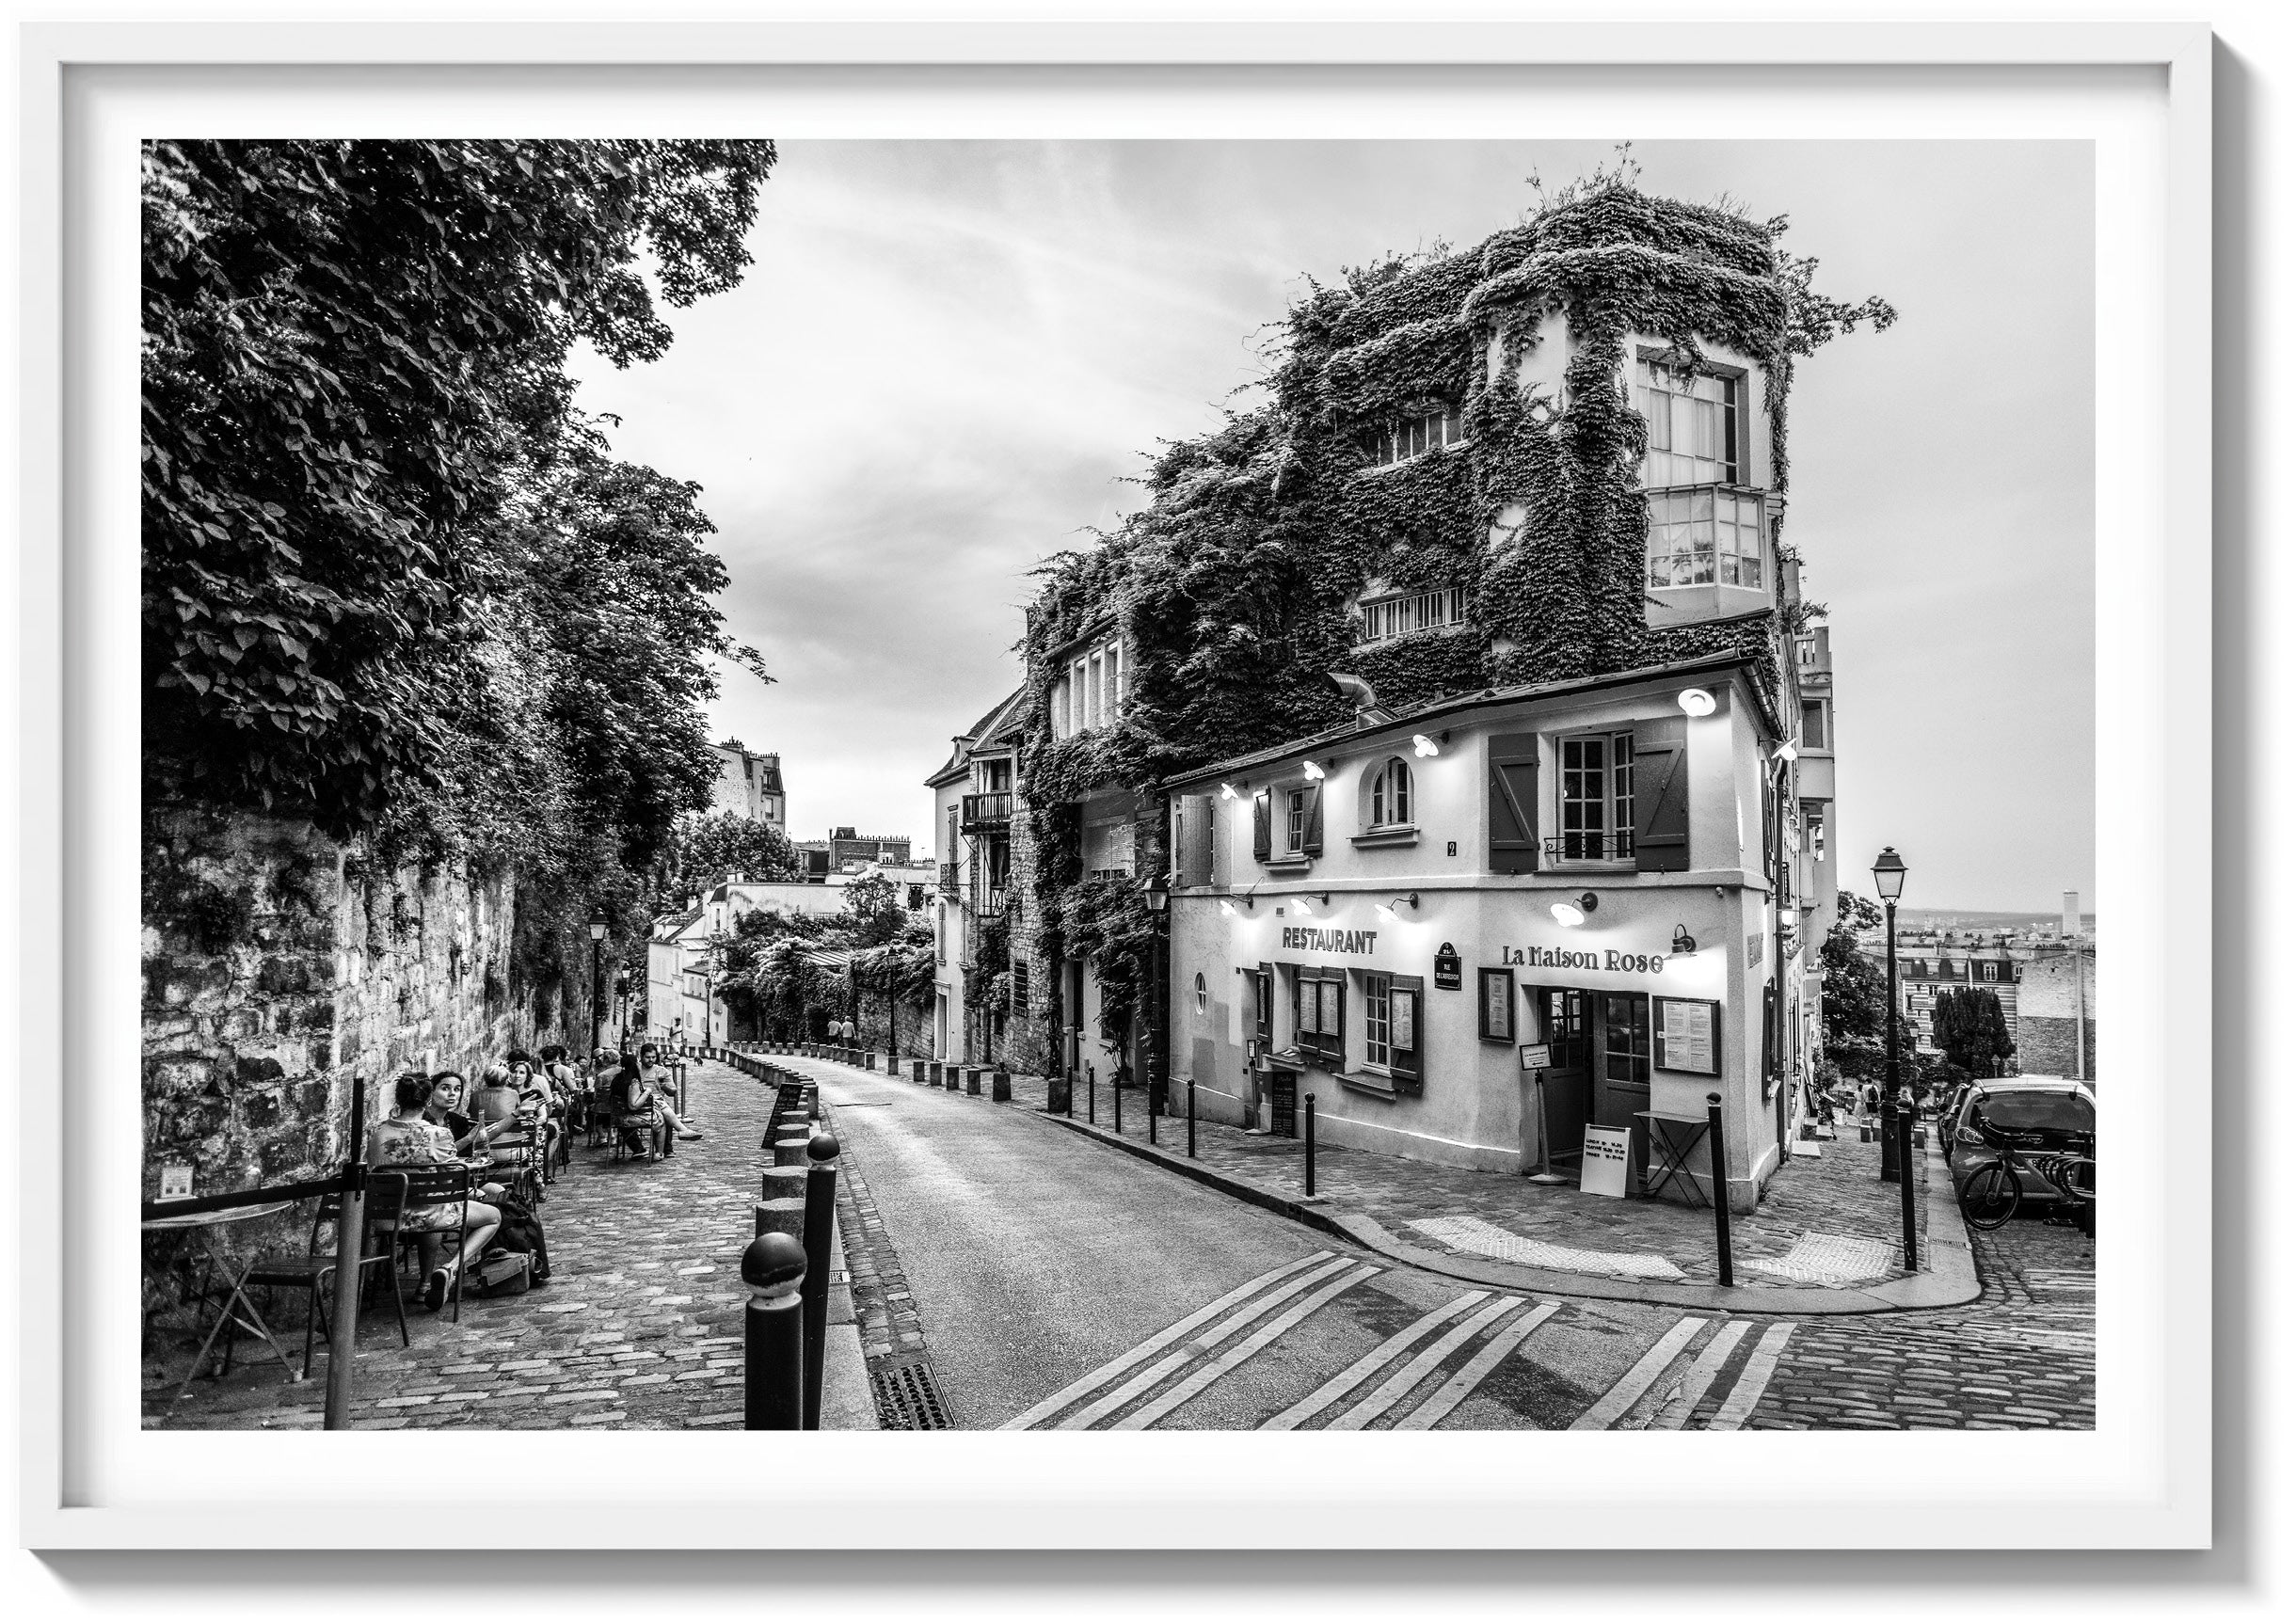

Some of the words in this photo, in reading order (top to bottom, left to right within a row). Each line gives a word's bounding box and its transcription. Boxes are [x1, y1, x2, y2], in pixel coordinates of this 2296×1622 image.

[1449, 843, 1455, 855] 2
[1282, 927, 1378, 955] RESTAURANT
[1502, 946, 1525, 966] La
[1527, 946, 1600, 971] Maison
[1603, 948, 1664, 975] Rose
